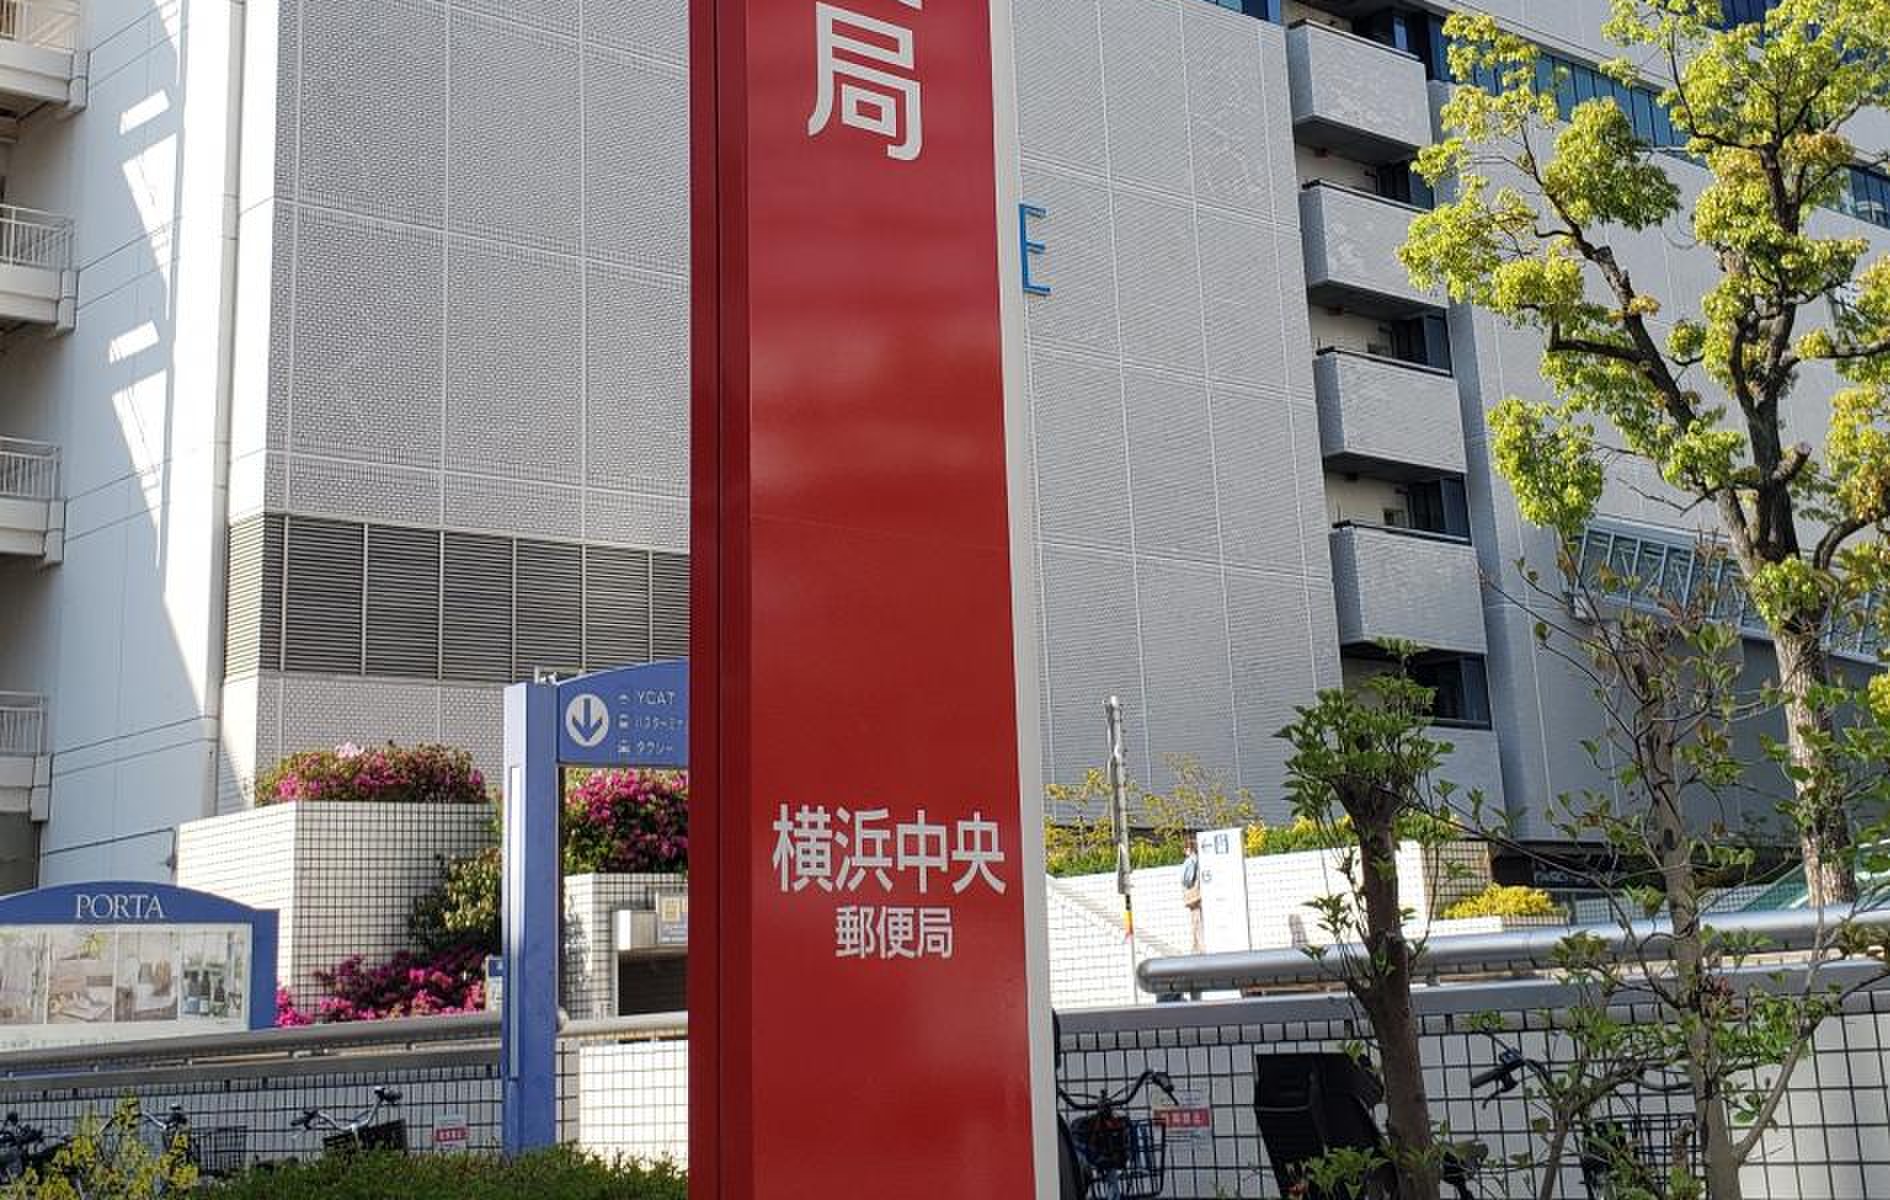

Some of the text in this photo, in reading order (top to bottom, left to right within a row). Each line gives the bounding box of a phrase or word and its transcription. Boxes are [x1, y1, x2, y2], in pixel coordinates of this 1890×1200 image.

[772, 803, 1006, 895] 横浜中央
[76, 893, 165, 919] PORTA
[834, 905, 955, 960] 郵便局
